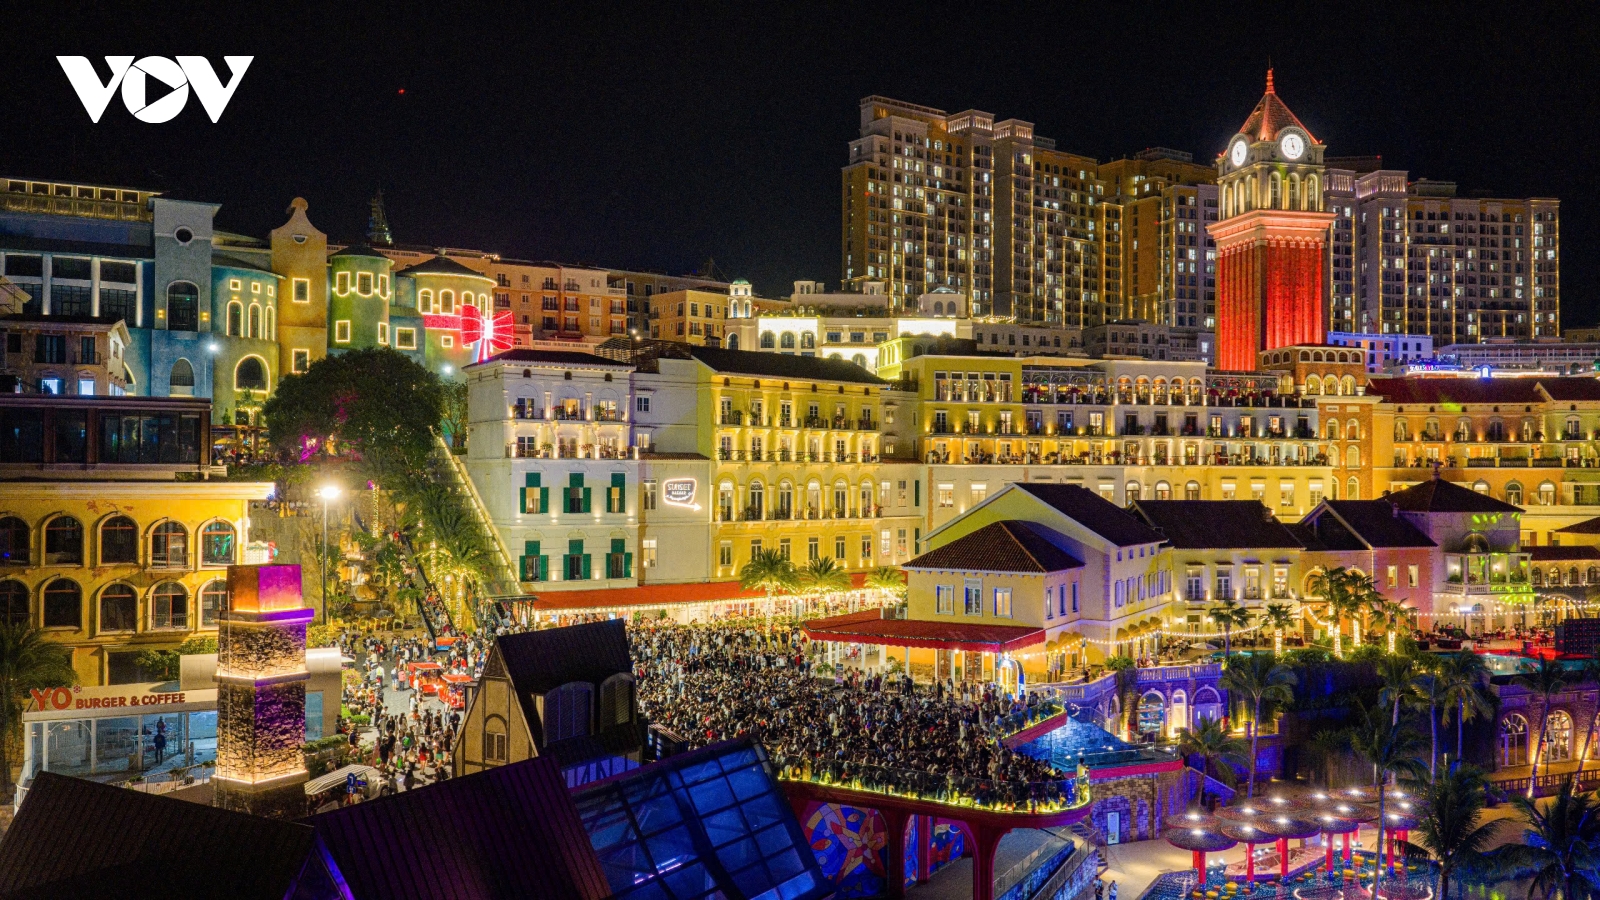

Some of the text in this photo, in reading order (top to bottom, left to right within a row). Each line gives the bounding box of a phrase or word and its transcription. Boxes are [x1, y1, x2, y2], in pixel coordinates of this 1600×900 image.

[30, 686, 185, 712] YO BURGER & COFFEE
